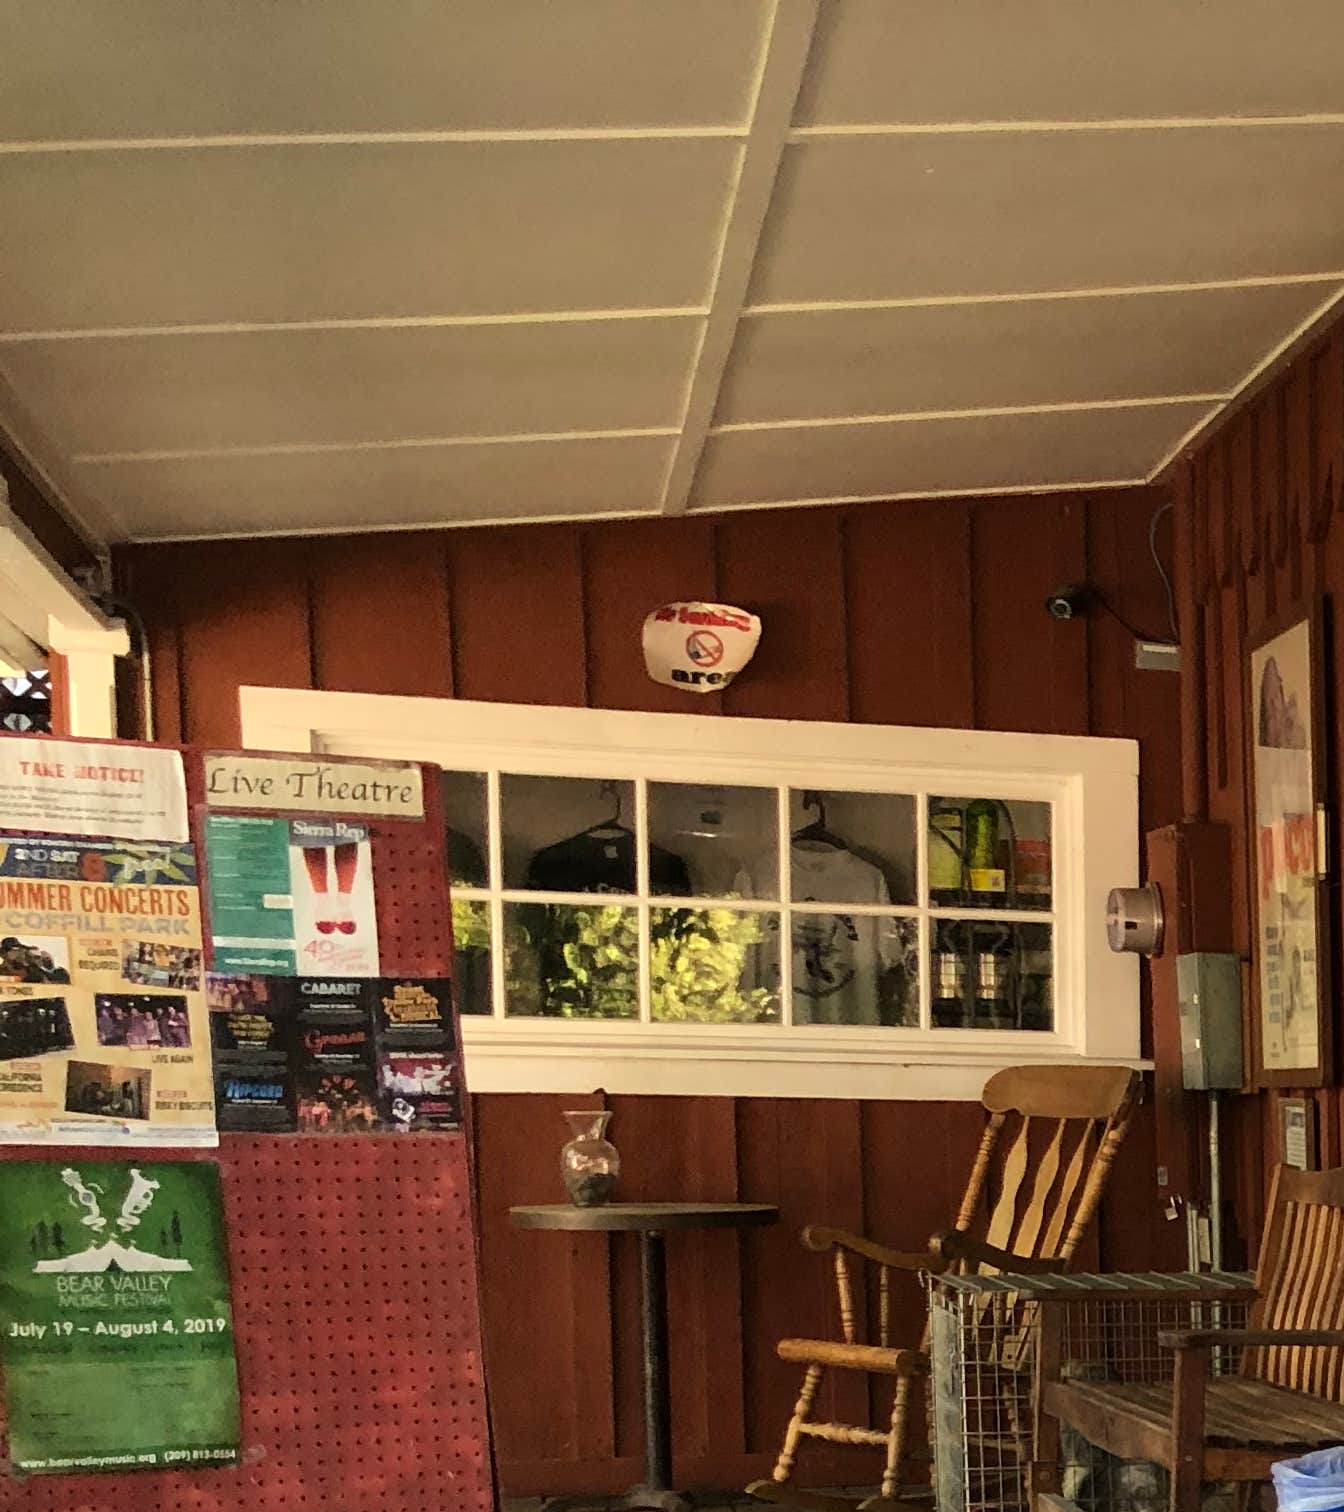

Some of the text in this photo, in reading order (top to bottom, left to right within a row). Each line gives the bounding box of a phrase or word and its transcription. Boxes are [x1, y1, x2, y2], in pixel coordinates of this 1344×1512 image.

[208, 766, 414, 804] Live Theatre
[80, 886, 191, 917] CONCERTS
[5, 911, 190, 935] COFFILL PARK
[301, 982, 362, 996] CABARET
[56, 1275, 172, 1293] BEAR VALLEY
[9, 1317, 226, 1339] July 19 August 4, 2019
